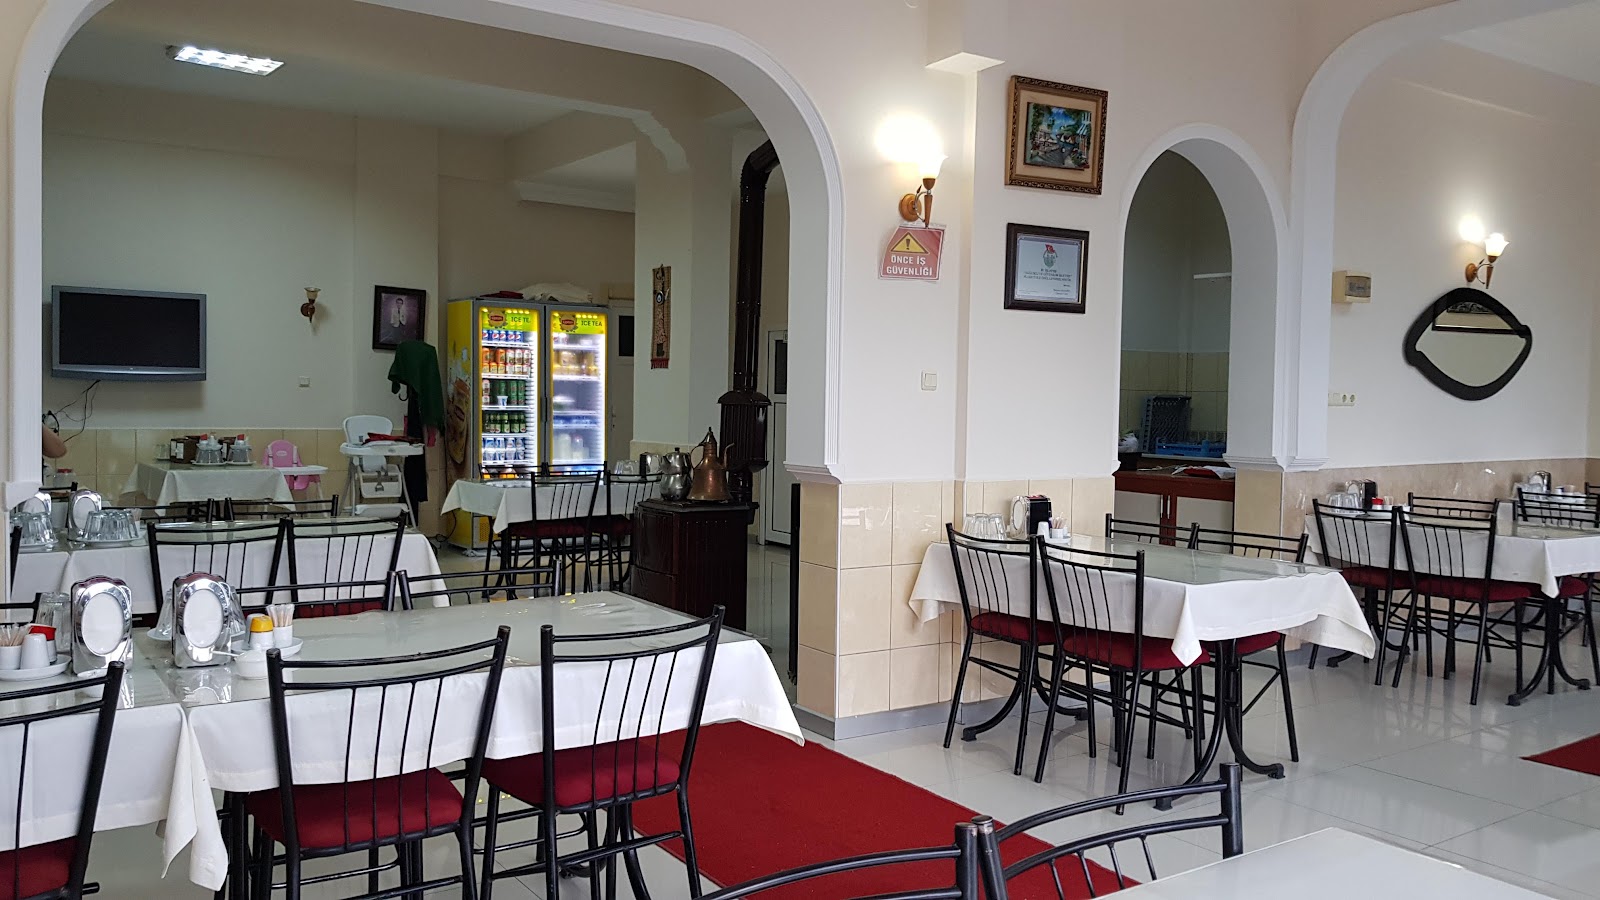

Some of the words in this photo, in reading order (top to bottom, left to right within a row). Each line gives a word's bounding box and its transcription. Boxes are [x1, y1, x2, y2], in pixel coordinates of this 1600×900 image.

[891, 255, 914, 264] ÖNCE
[916, 256, 926, 266] İŞ
[886, 266, 933, 276] GÜVENLİĞİ
